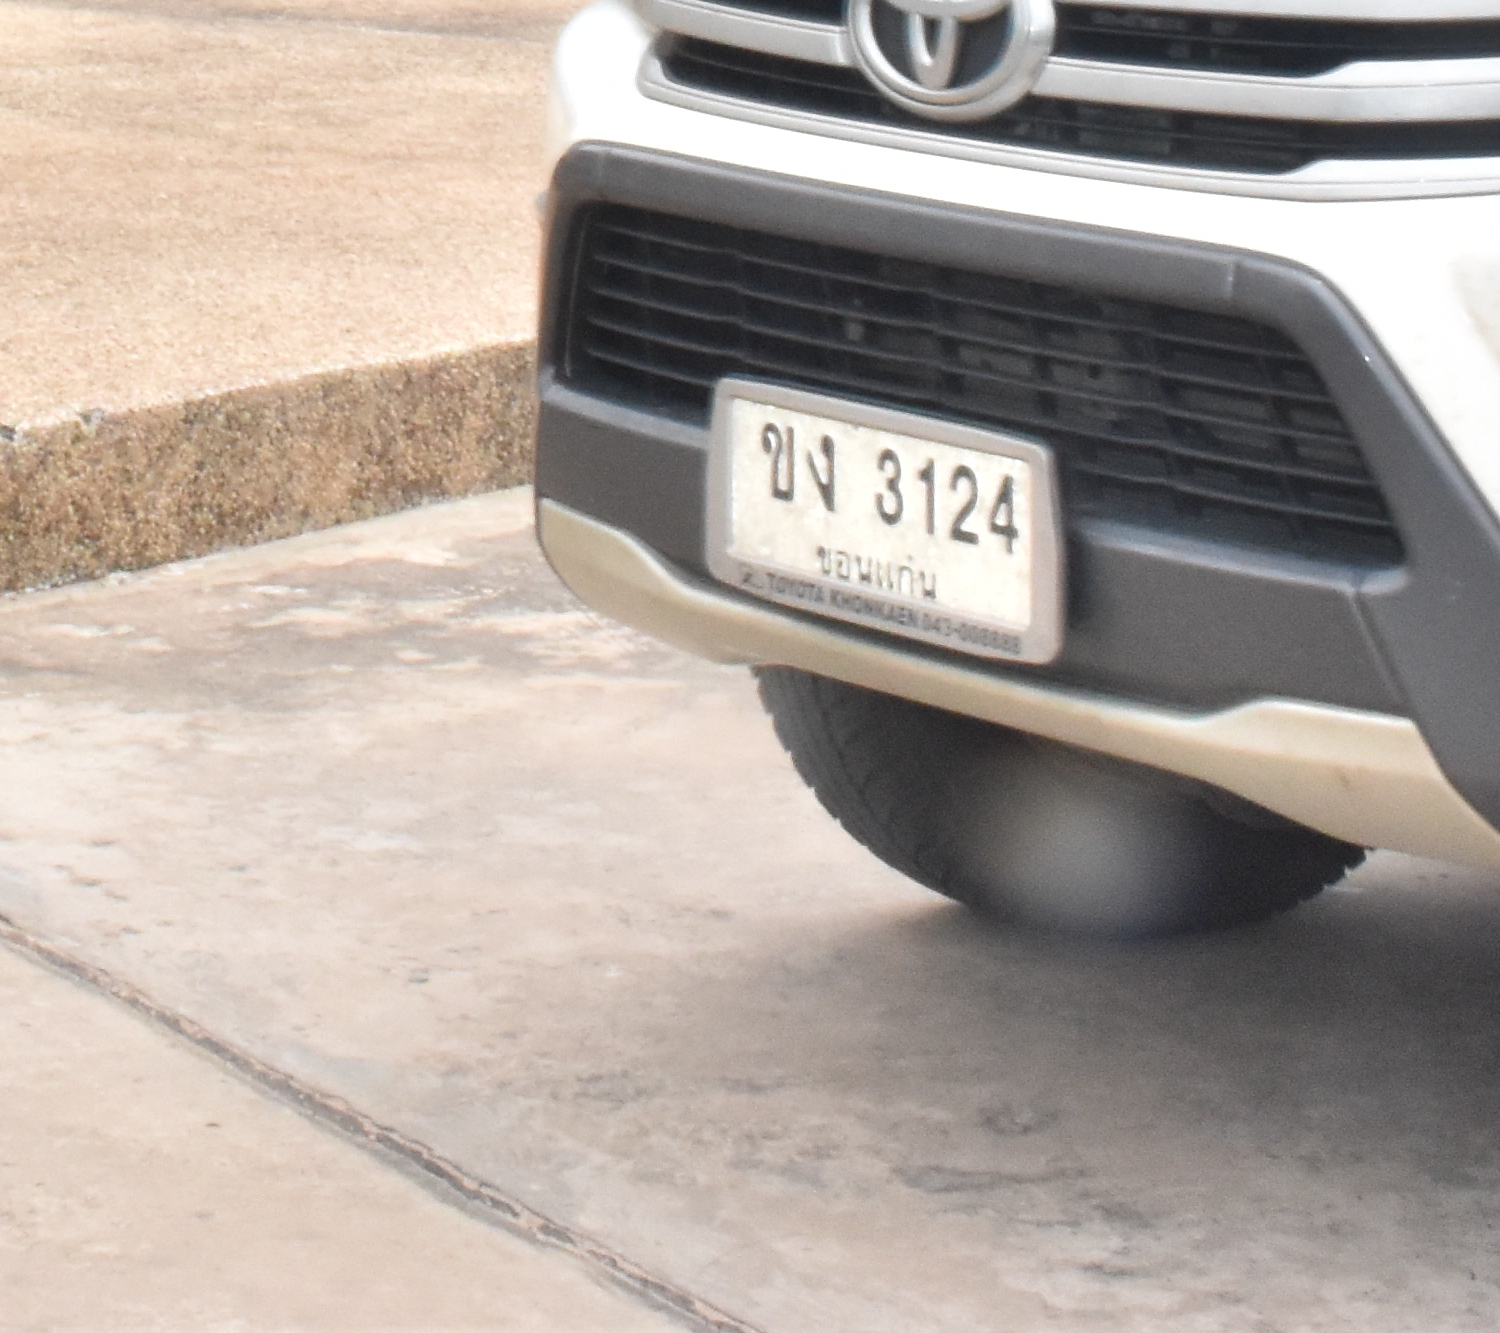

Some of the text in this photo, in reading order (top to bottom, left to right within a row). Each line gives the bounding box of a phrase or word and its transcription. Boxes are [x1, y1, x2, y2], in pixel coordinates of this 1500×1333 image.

[761, 422, 1019, 554] ขง 3124
[765, 572, 824, 603] TOYOTA
[816, 545, 938, 600] ขอนแก่น
